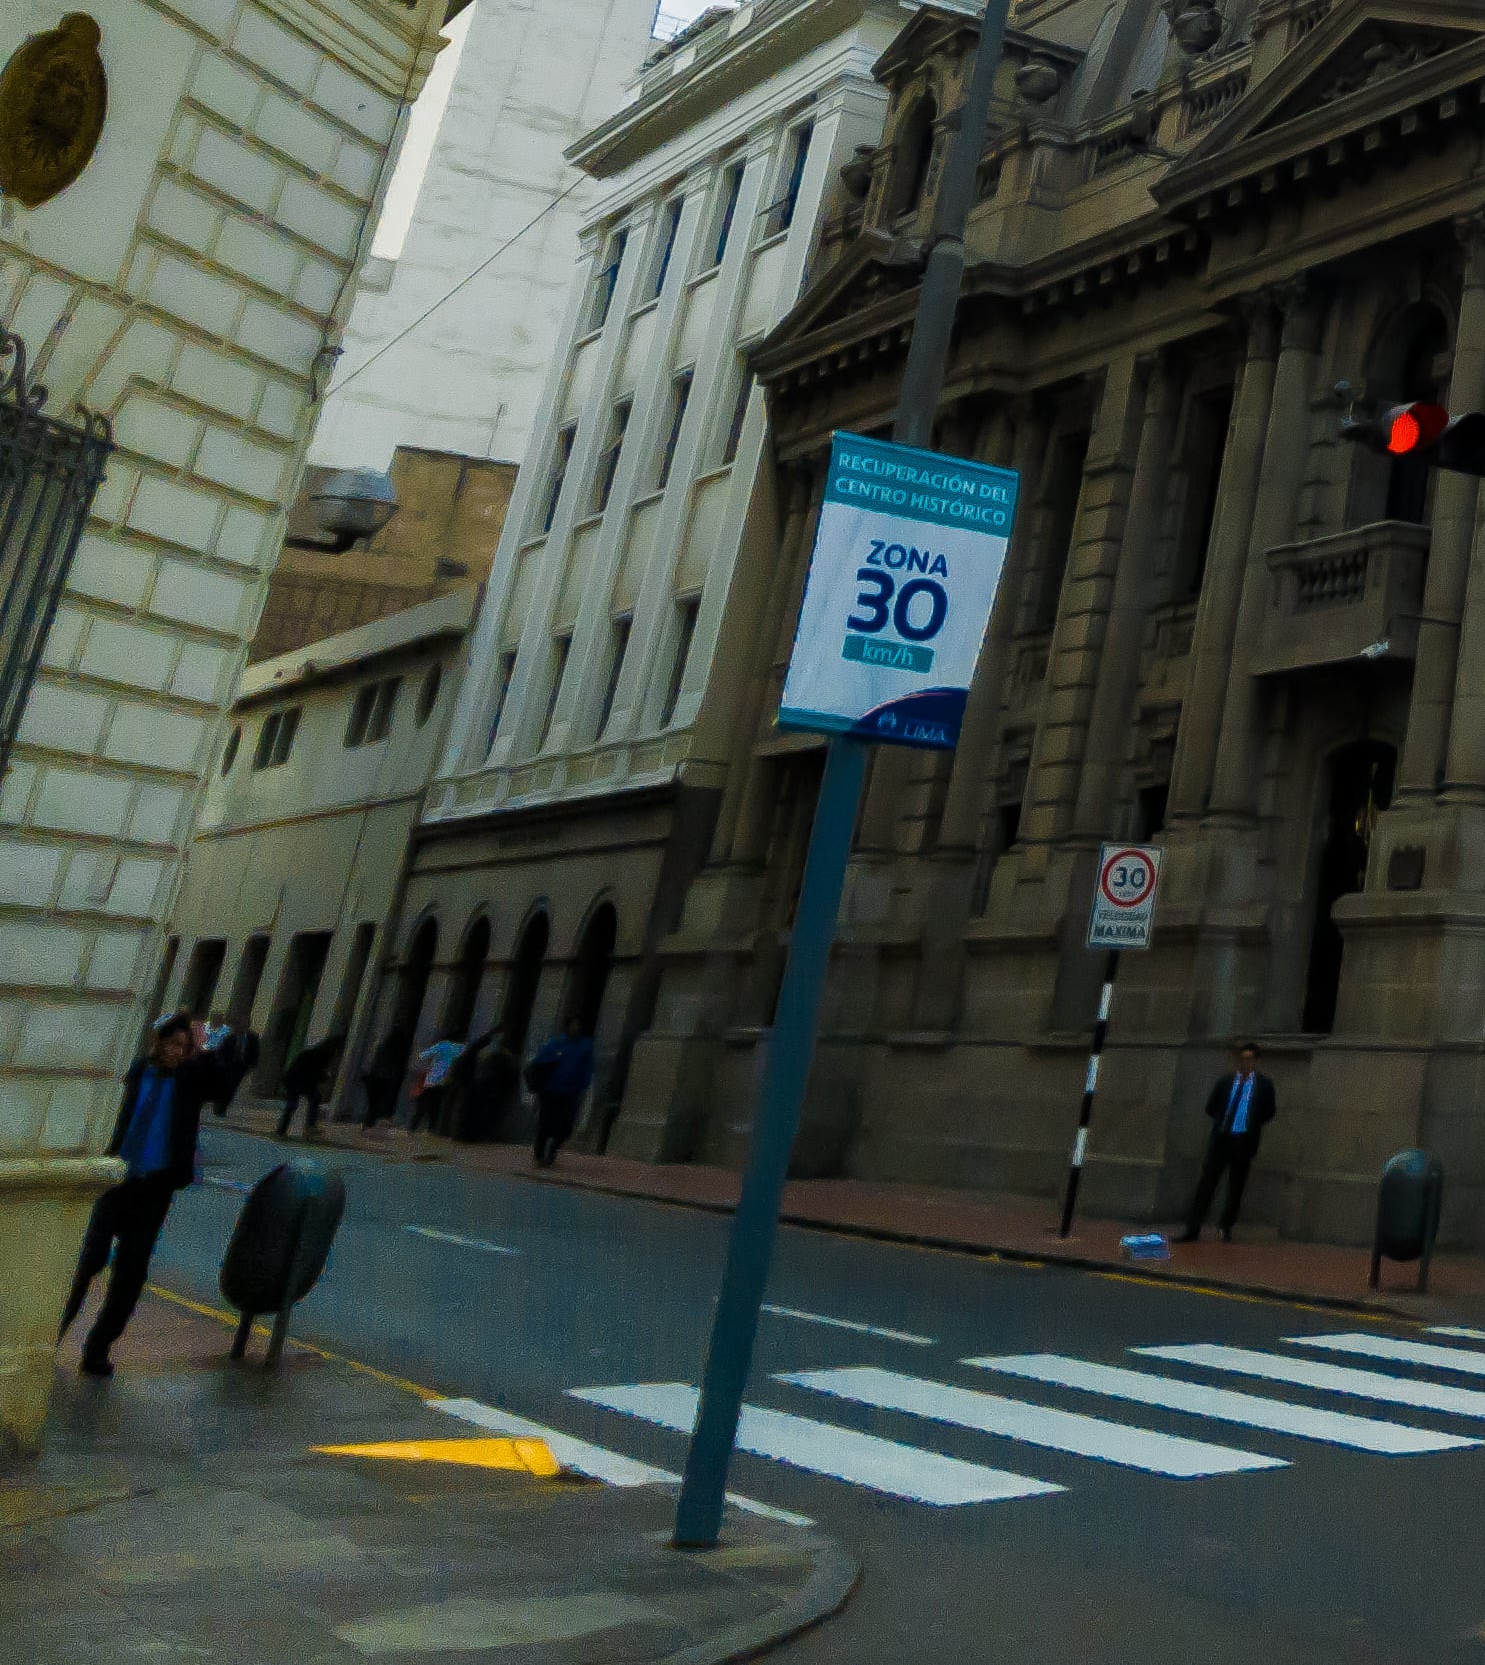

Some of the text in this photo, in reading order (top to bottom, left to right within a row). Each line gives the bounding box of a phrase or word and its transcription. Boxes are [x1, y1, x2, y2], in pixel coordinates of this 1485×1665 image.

[838, 452, 1008, 504] RECUPERACIÓN DEL
[835, 475, 1006, 526] CENTRO HISTÓRICO
[865, 539, 948, 578] ZONA
[846, 567, 949, 642] 30
[862, 639, 913, 666] km/h
[903, 723, 946, 742] LIMA
[1112, 865, 1146, 889] 30
